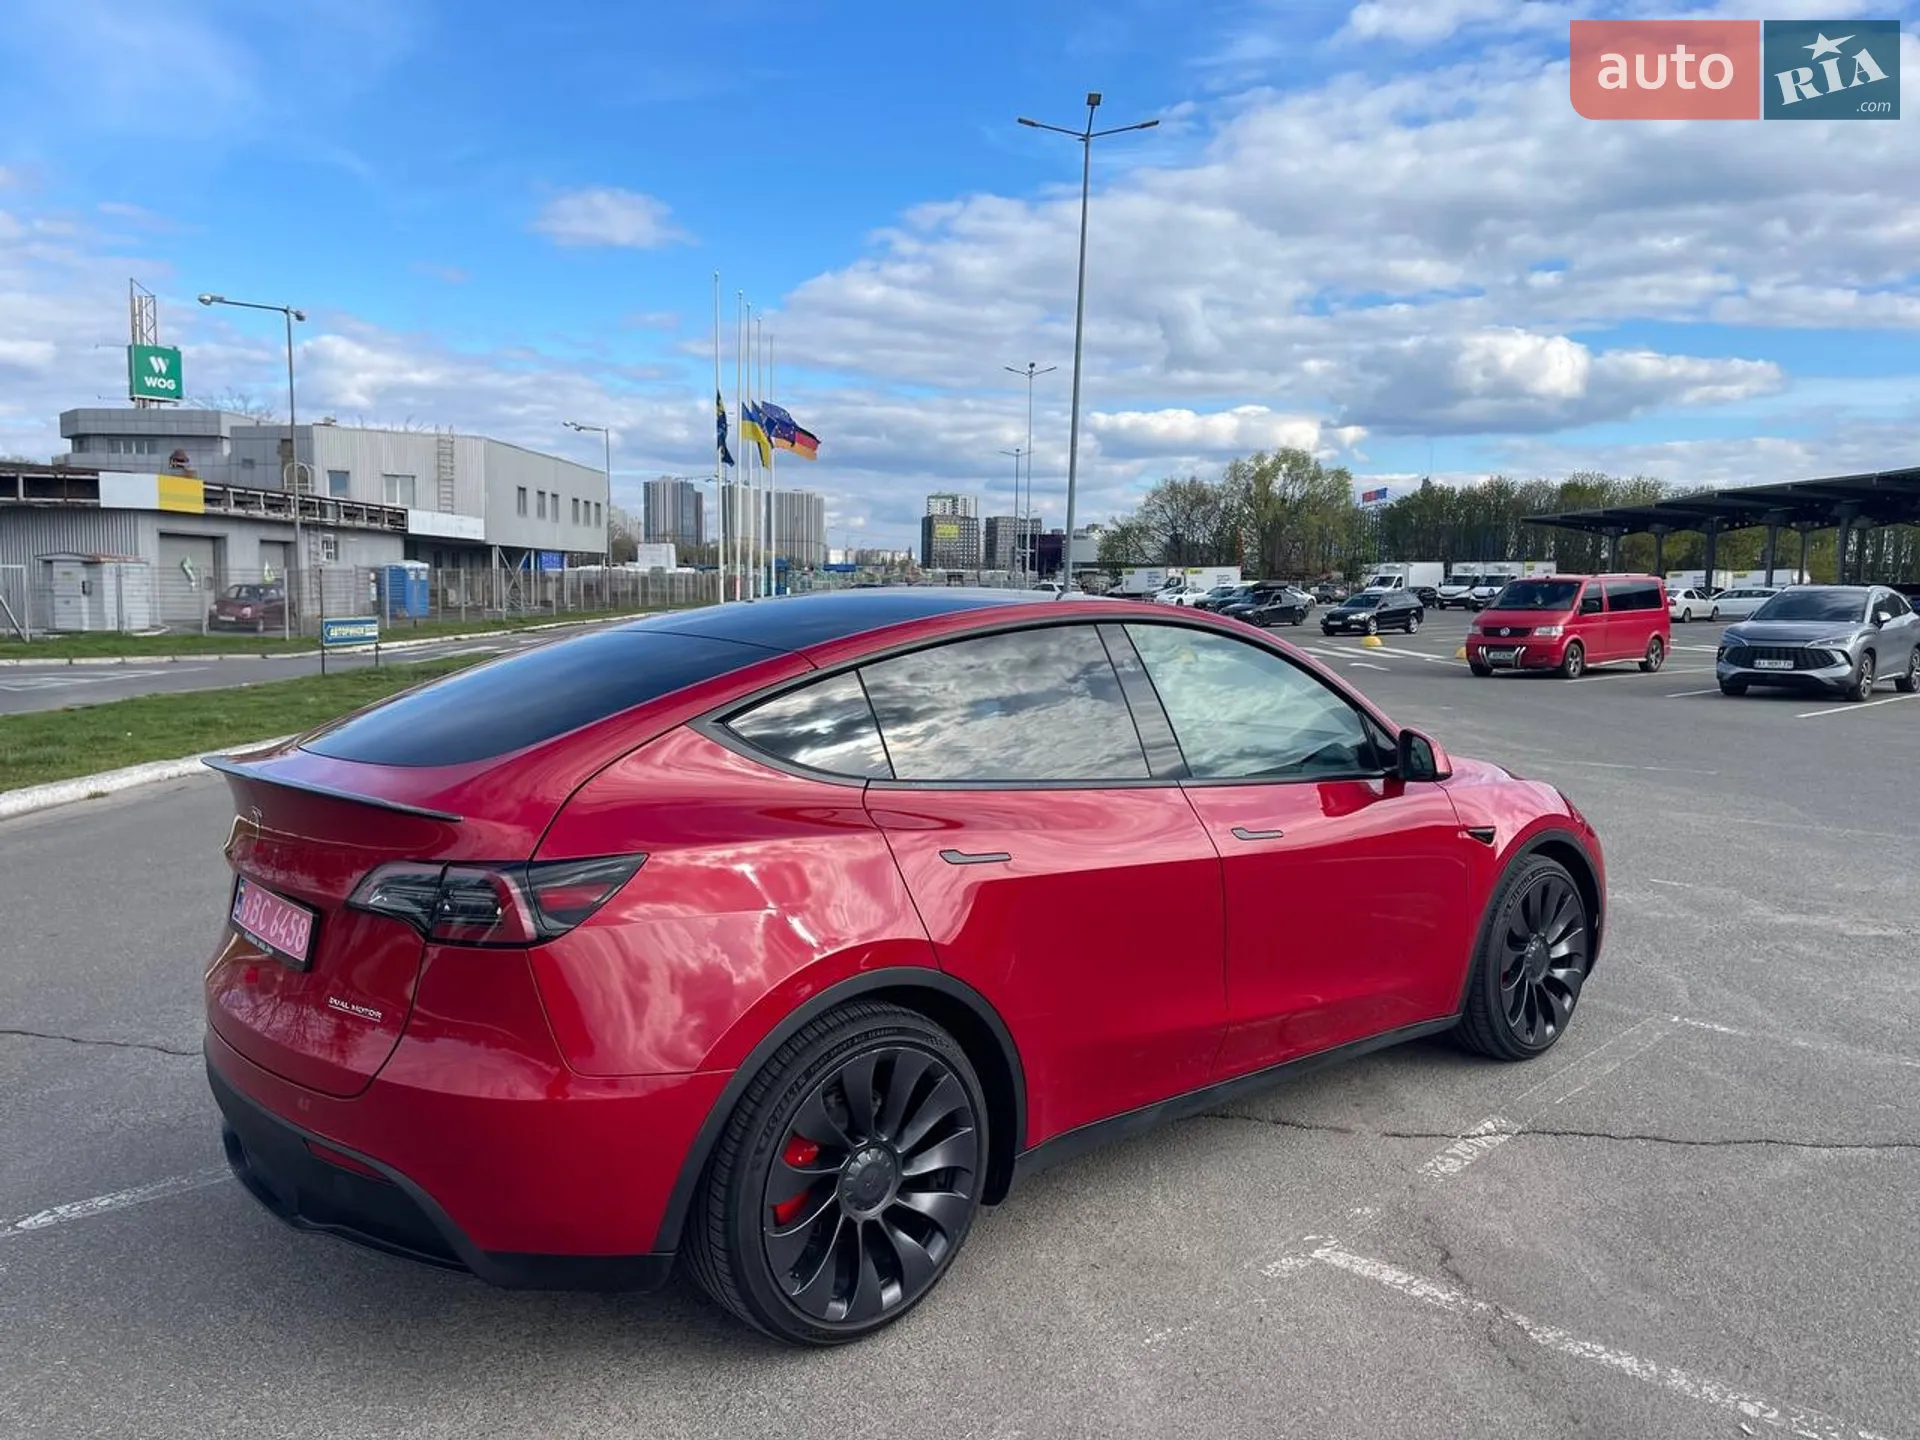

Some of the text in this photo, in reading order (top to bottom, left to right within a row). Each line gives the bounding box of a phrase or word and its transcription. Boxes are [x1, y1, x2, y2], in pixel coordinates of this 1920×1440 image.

[144, 376, 176, 390] WOG
[269, 905, 309, 952] 6458
[329, 996, 382, 1019] DUAL MOTOR
